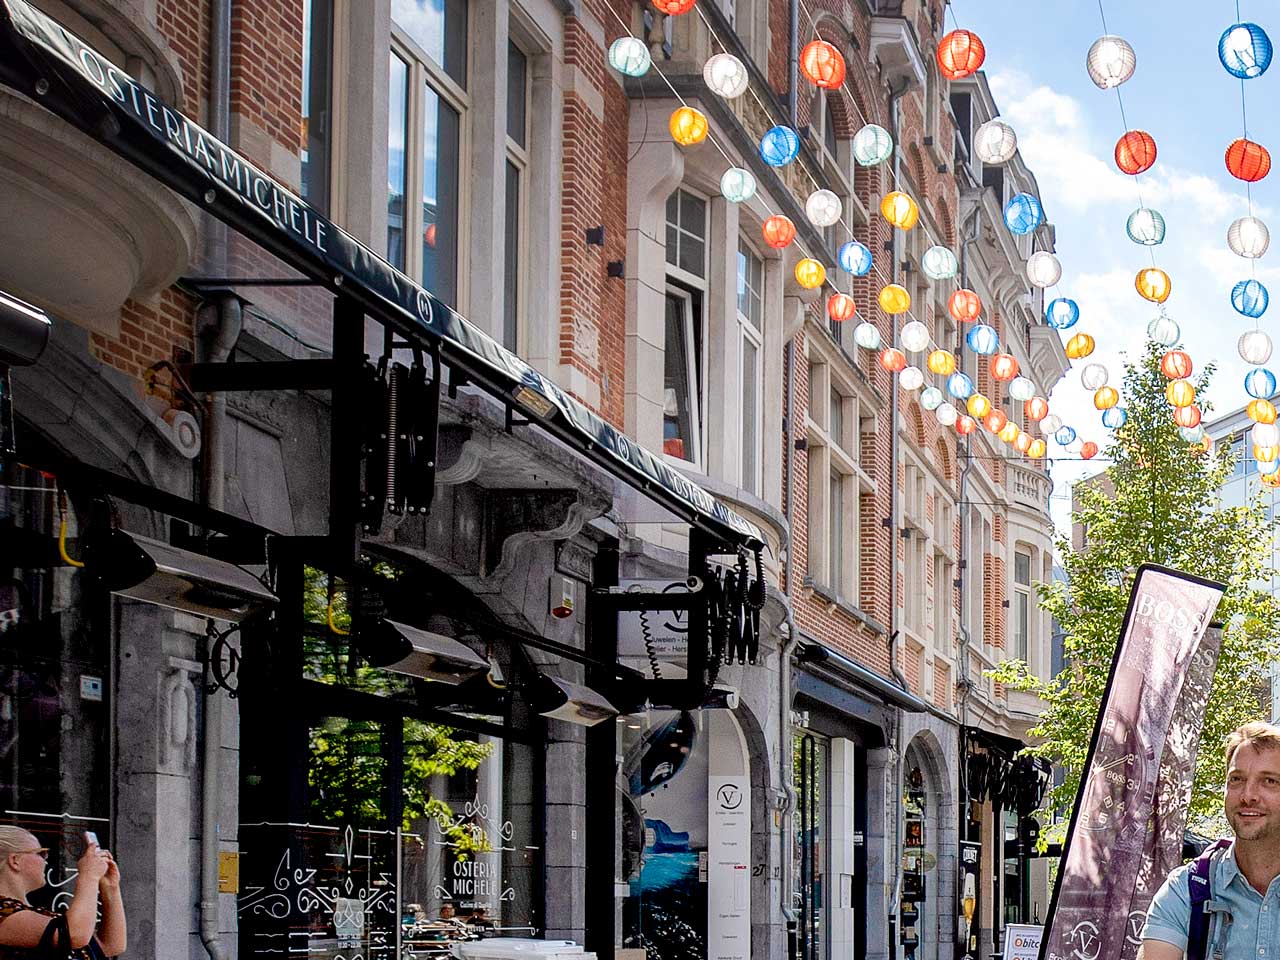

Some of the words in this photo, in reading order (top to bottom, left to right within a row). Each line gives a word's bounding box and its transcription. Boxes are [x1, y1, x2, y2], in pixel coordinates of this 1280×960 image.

[79, 48, 213, 172] OSTERIA
[219, 149, 328, 253] MICHELE
[1136, 592, 1205, 634] BOSS
[453, 860, 497, 878] OSTERIA
[752, 863, 766, 877] 27
[453, 879, 497, 895] MICHELE
